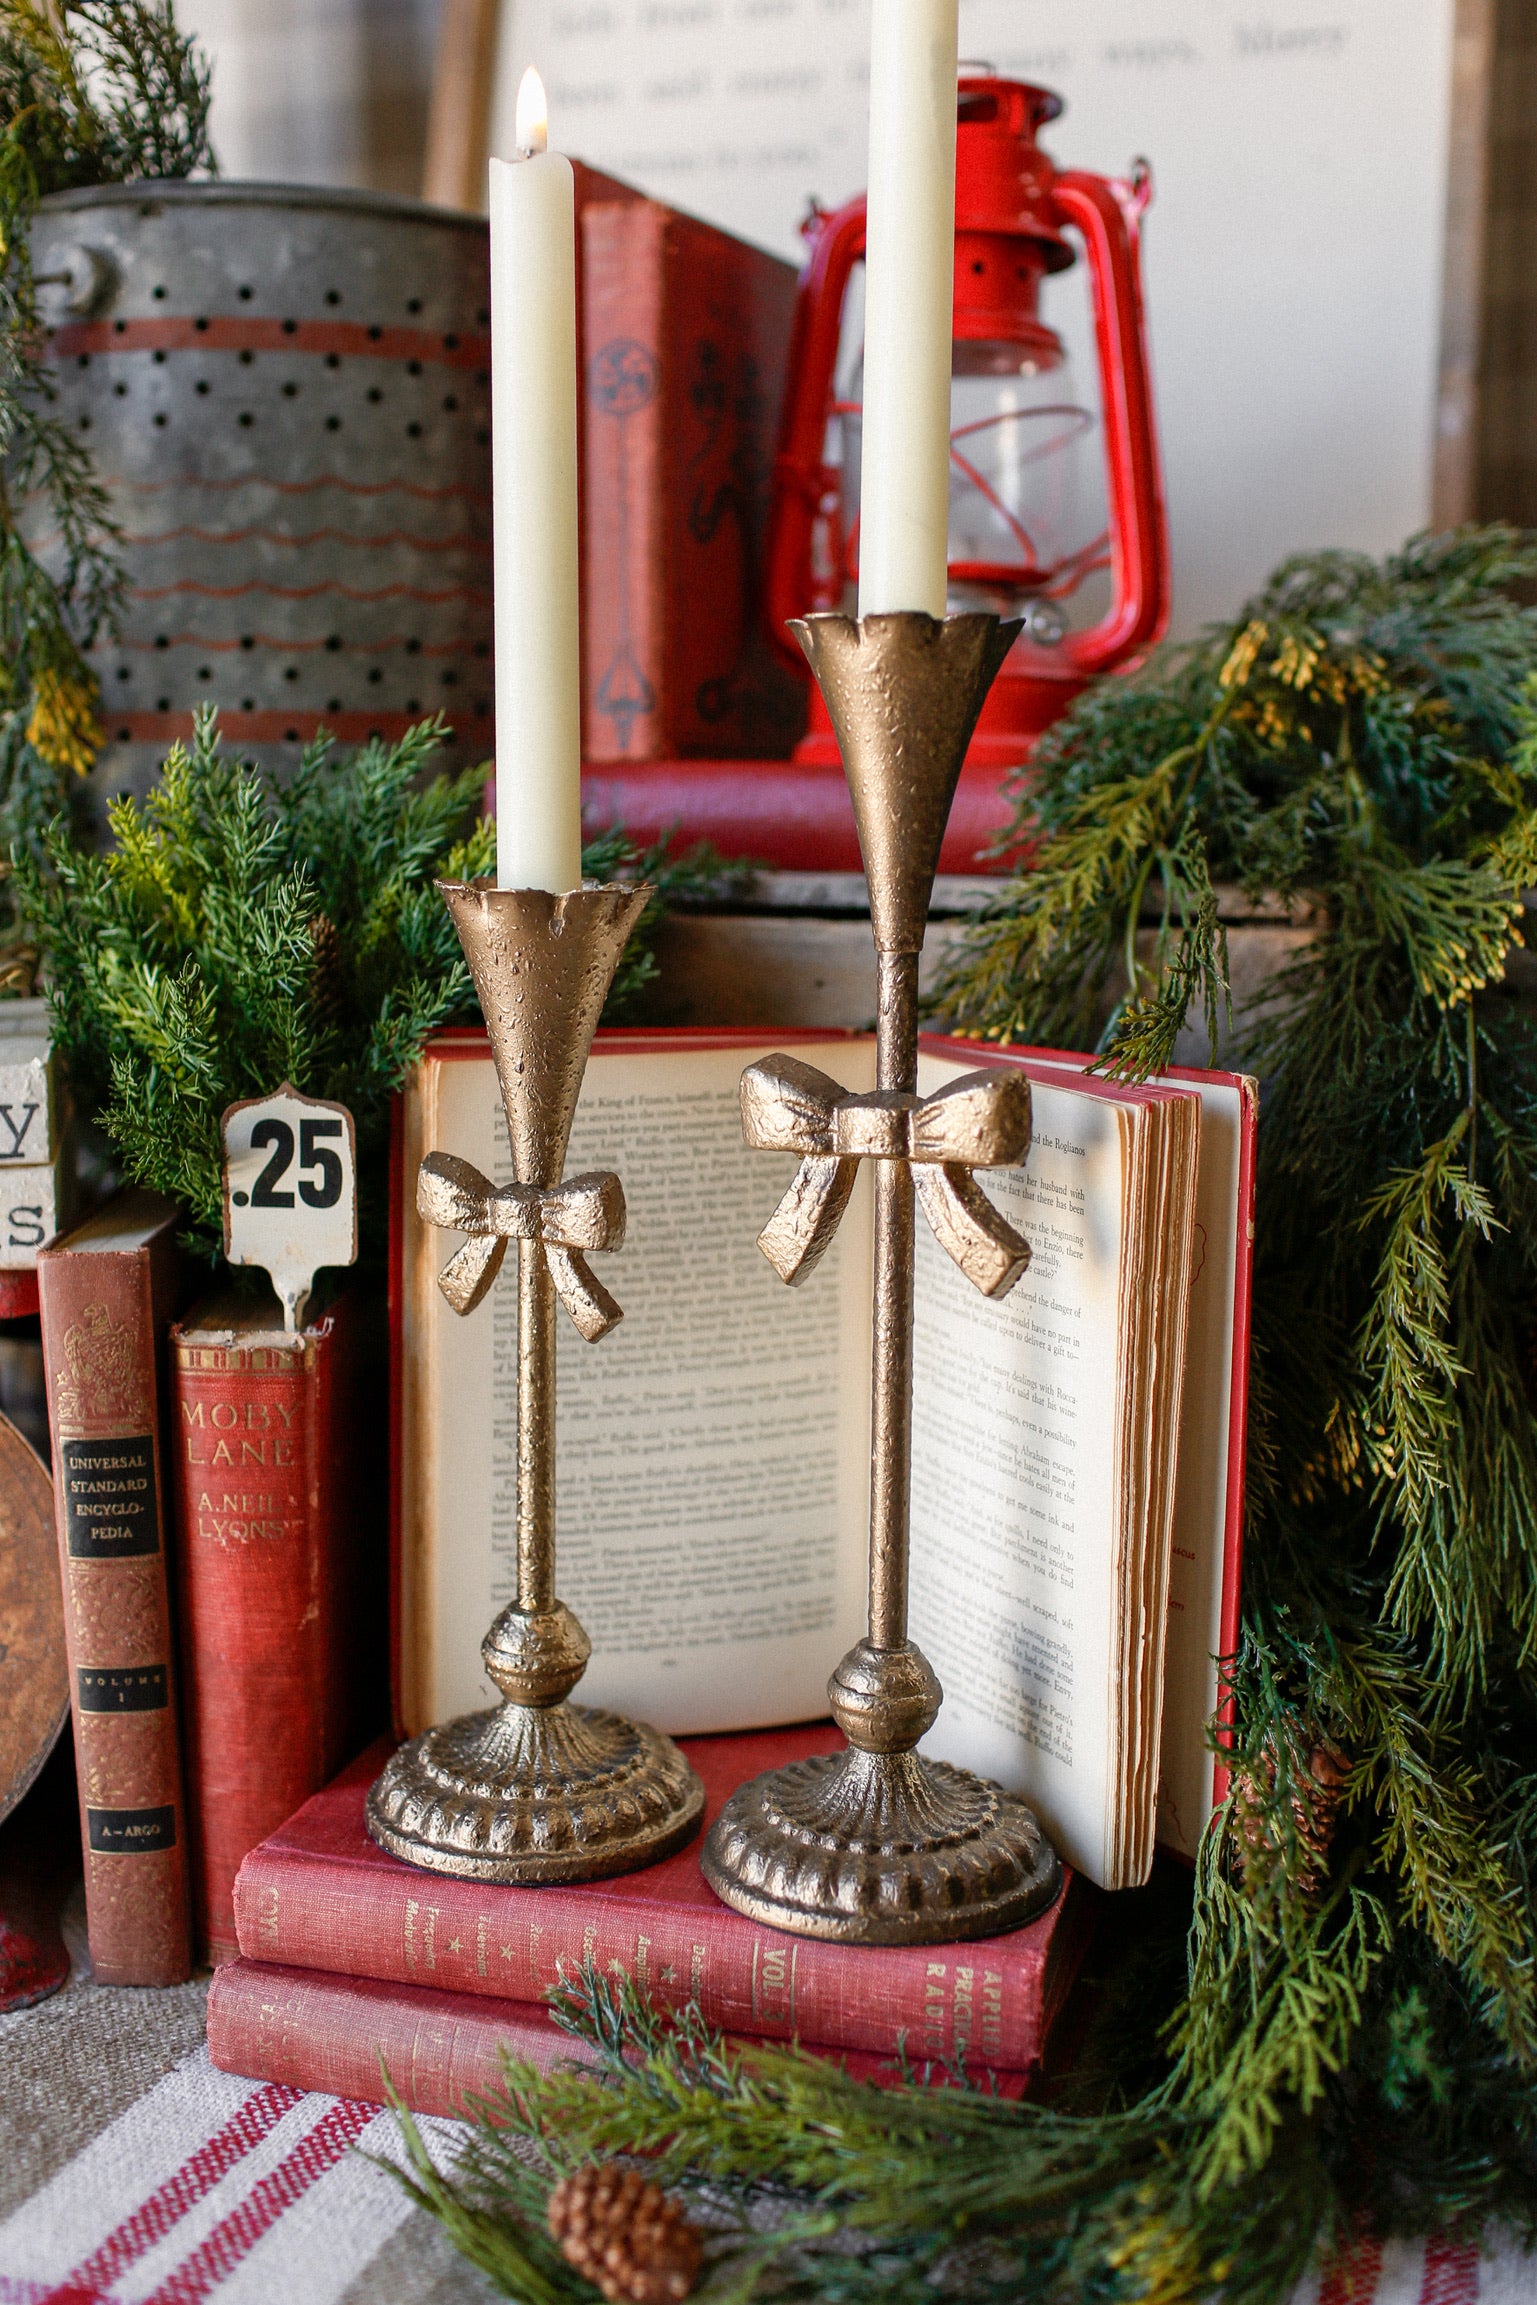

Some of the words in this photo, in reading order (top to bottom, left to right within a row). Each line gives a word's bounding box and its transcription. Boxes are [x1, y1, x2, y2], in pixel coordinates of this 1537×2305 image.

[1043, 1135, 1053, 1148] the
[1055, 1138, 1086, 1156] Roglianos
[232, 1119, 344, 1209] .25
[1027, 1174, 1037, 1187] her
[1040, 1178, 1067, 1195] husband
[1070, 1188, 1085, 1200] with
[1009, 1184, 1020, 1197] fact
[1022, 1188, 1035, 1201] that
[1037, 1193, 1054, 1206] there
[1056, 1197, 1067, 1210] has
[1069, 1201, 1085, 1215] been
[1005, 1211, 1023, 1227] There
[1025, 1220, 1036, 1230] was
[1039, 1222, 1049, 1234] the
[1051, 1225, 1084, 1247] beginning
[1035, 1237, 1041, 1246] to
[1066, 1246, 1083, 1260] there
[1038, 1295, 1049, 1308] the
[1050, 1299, 1073, 1316] danger
[1074, 1308, 1081, 1318] of
[1024, 1332, 1046, 1349] deliver
[1031, 1320, 1046, 1335] have
[1048, 1330, 1057, 1339] no
[1058, 1333, 1071, 1346] part
[1073, 1337, 1080, 1347] in
[1040, 1384, 1054, 1397] with
[1032, 1393, 1044, 1407] that
[1047, 1398, 1057, 1412] his
[181, 1400, 299, 1430] MOBY
[1022, 1420, 1037, 1432] even
[1044, 1428, 1077, 1449] possibility
[187, 1437, 296, 1466] LANE
[1021, 1445, 1050, 1465] Abraham
[69, 1456, 146, 1470] UNIVERSAL
[70, 1479, 148, 1493] STANDARD
[1042, 1468, 1050, 1480] all
[1068, 1480, 1075, 1490] of
[1064, 1491, 1075, 1504] the
[91, 1527, 133, 1539] PEDIA
[198, 1517, 285, 1541] LYONS
[1048, 1512, 1060, 1526] ink
[1062, 1522, 1074, 1533] and
[1032, 1536, 1048, 1548] need
[1050, 1544, 1065, 1558] only
[1067, 1551, 1074, 1561] to
[1048, 1556, 1074, 1575] another
[1048, 1569, 1057, 1580] do
[1060, 1574, 1074, 1589] find
[1061, 1659, 1074, 1672] and
[84, 1676, 162, 1687] VOLUME
[1057, 1671, 1073, 1686] some
[762, 1949, 786, 1997] VOL.
[763, 2006, 785, 2022] 3
[924, 1963, 946, 2049] RADIO
[982, 1969, 1003, 2056] APPLIED
